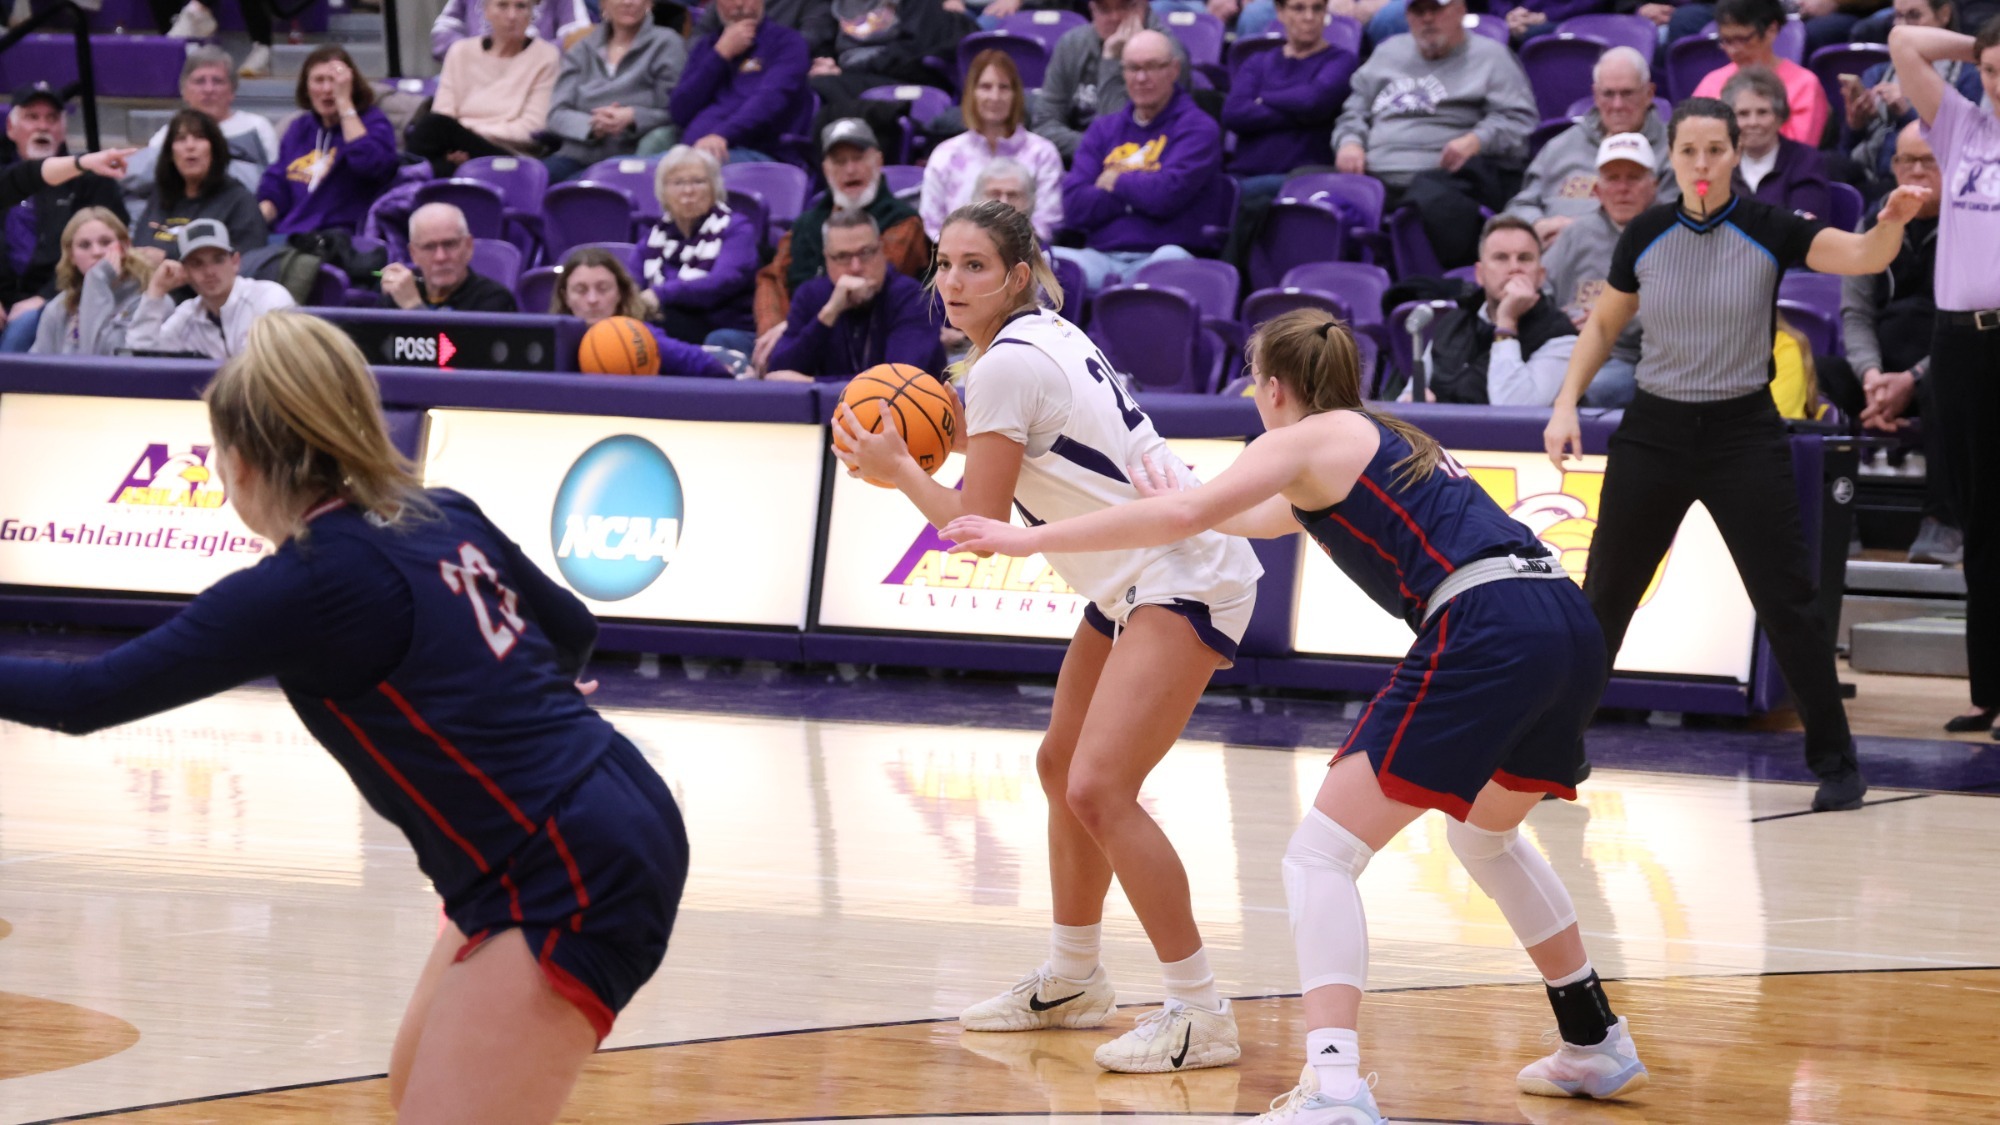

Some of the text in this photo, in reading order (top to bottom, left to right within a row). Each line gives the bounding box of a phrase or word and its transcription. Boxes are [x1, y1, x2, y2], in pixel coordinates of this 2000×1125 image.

[394, 336, 437, 361] POSS
[1085, 348, 1146, 433] 2
[116, 486, 225, 509] ASHLAND
[0, 518, 275, 557] GoAshlandEagles
[557, 514, 680, 563] NCAA
[903, 549, 1077, 594] ASHLA
[899, 591, 1077, 615] UNIVERSI
